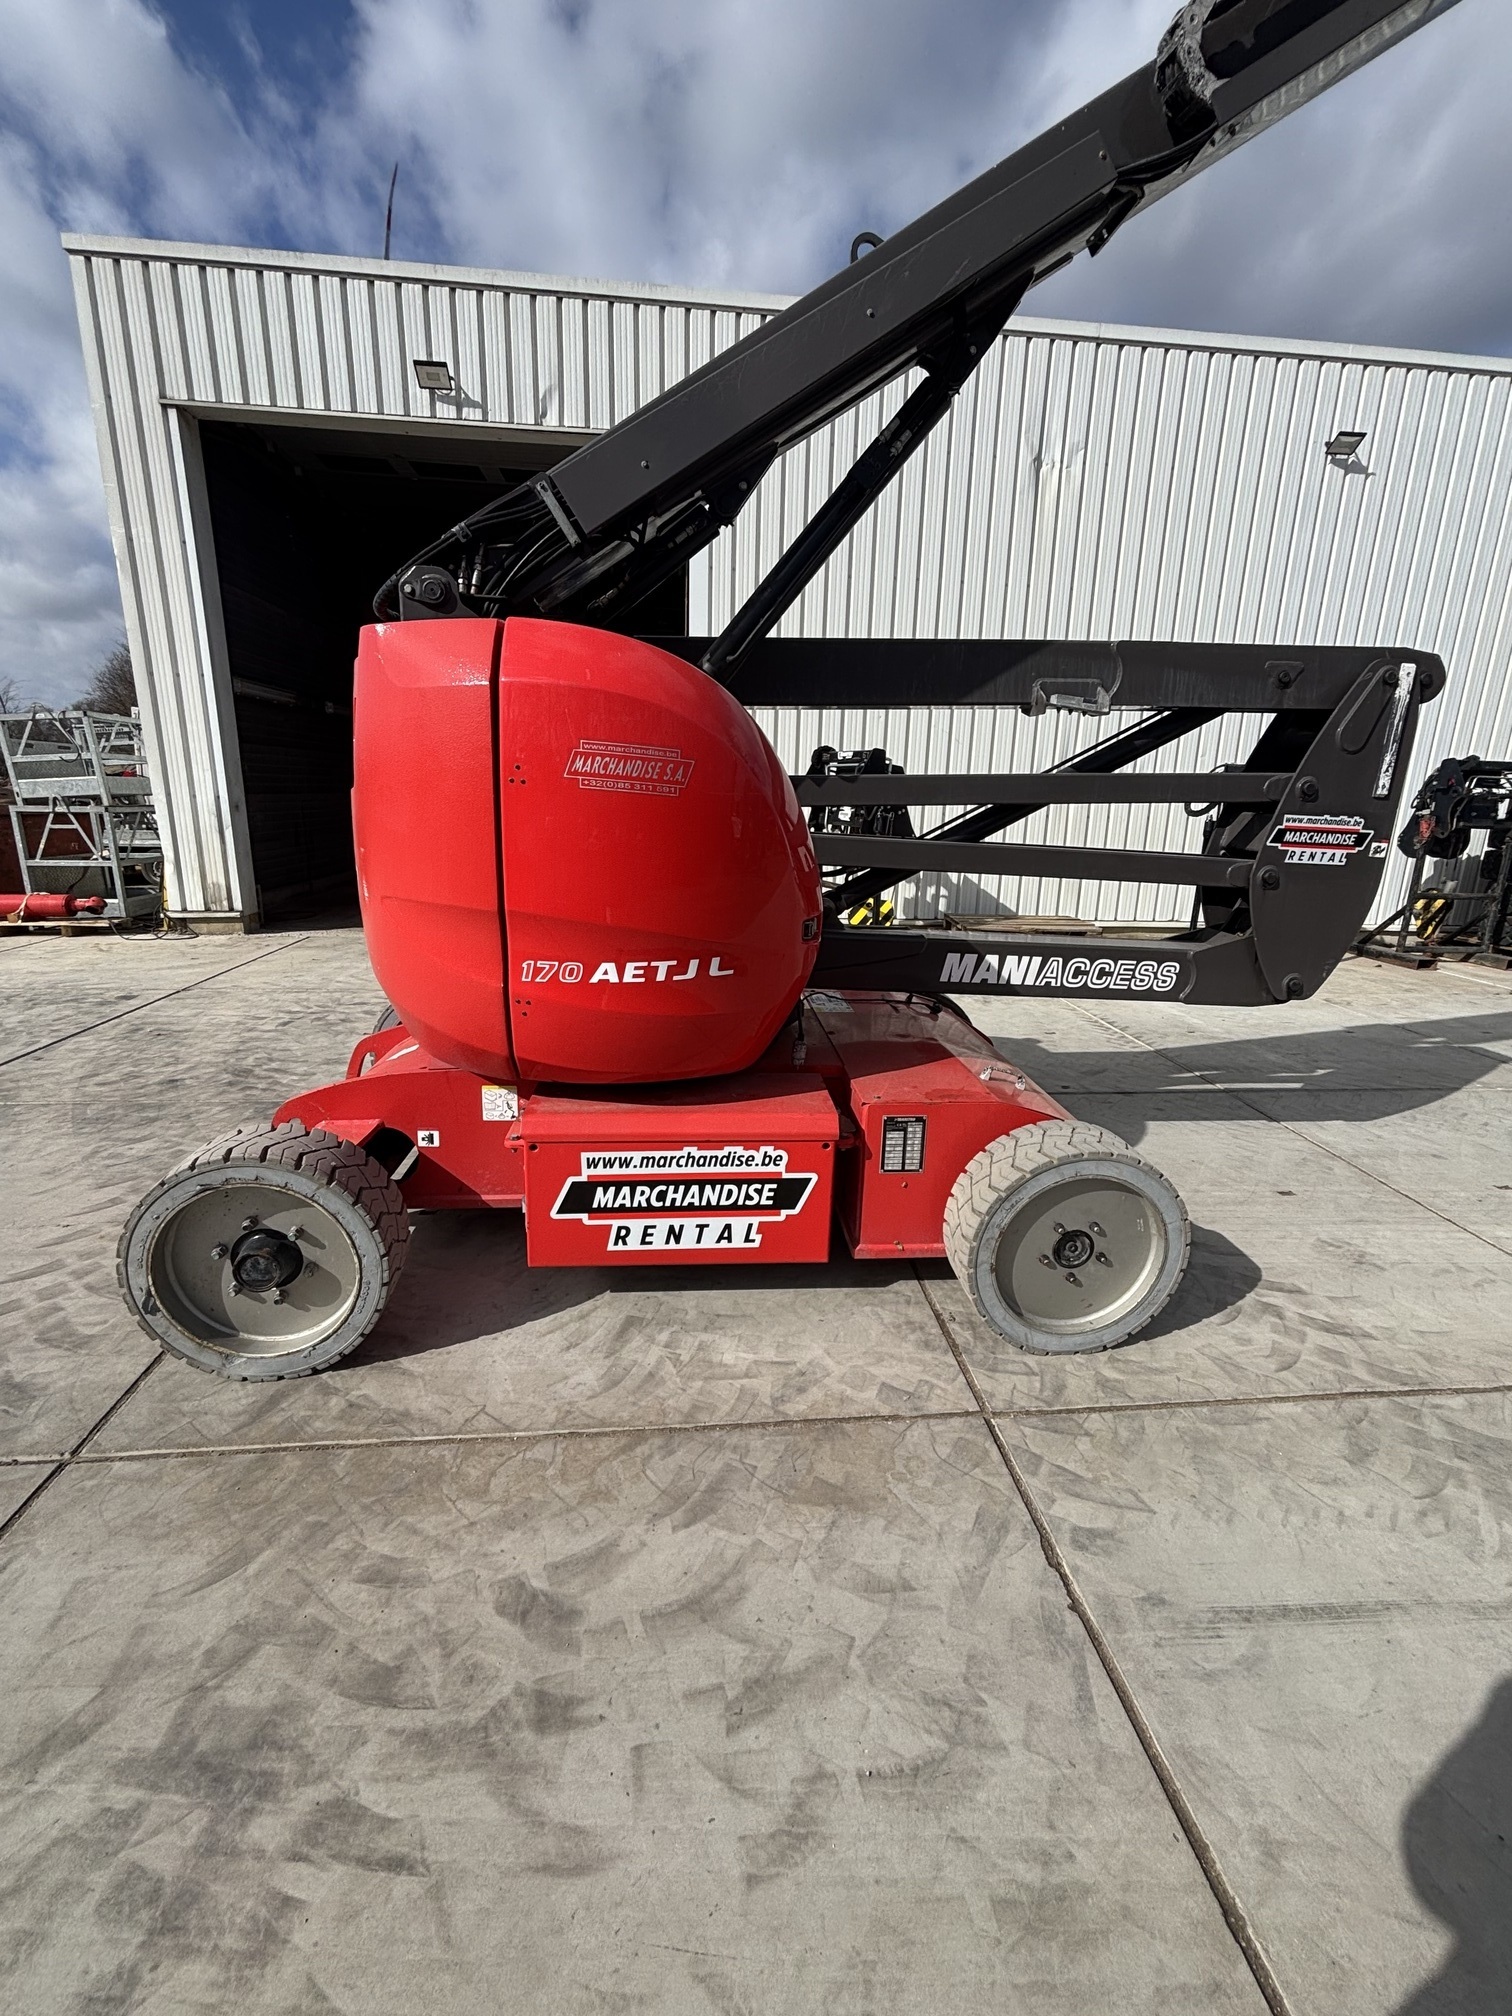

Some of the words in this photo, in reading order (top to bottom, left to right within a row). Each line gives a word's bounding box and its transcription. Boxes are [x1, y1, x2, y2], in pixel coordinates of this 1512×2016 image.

[583, 742, 678, 758] www.marchandise.be
[571, 754, 663, 780] MARCHANDISE
[663, 763, 686, 782] S.A.
[582, 779, 631, 790] +32(0)85
[1284, 816, 1363, 828] www.marchandise.be
[1283, 831, 1358, 846] MARCHANDISE
[1287, 850, 1346, 863] RENTAL
[521, 960, 584, 983] 170
[939, 952, 1181, 992] MANIACCESS
[585, 1150, 784, 1170] www.marchandise.be
[592, 1183, 778, 1209] MARCHANDISE
[612, 1222, 758, 1247] RENTAL
